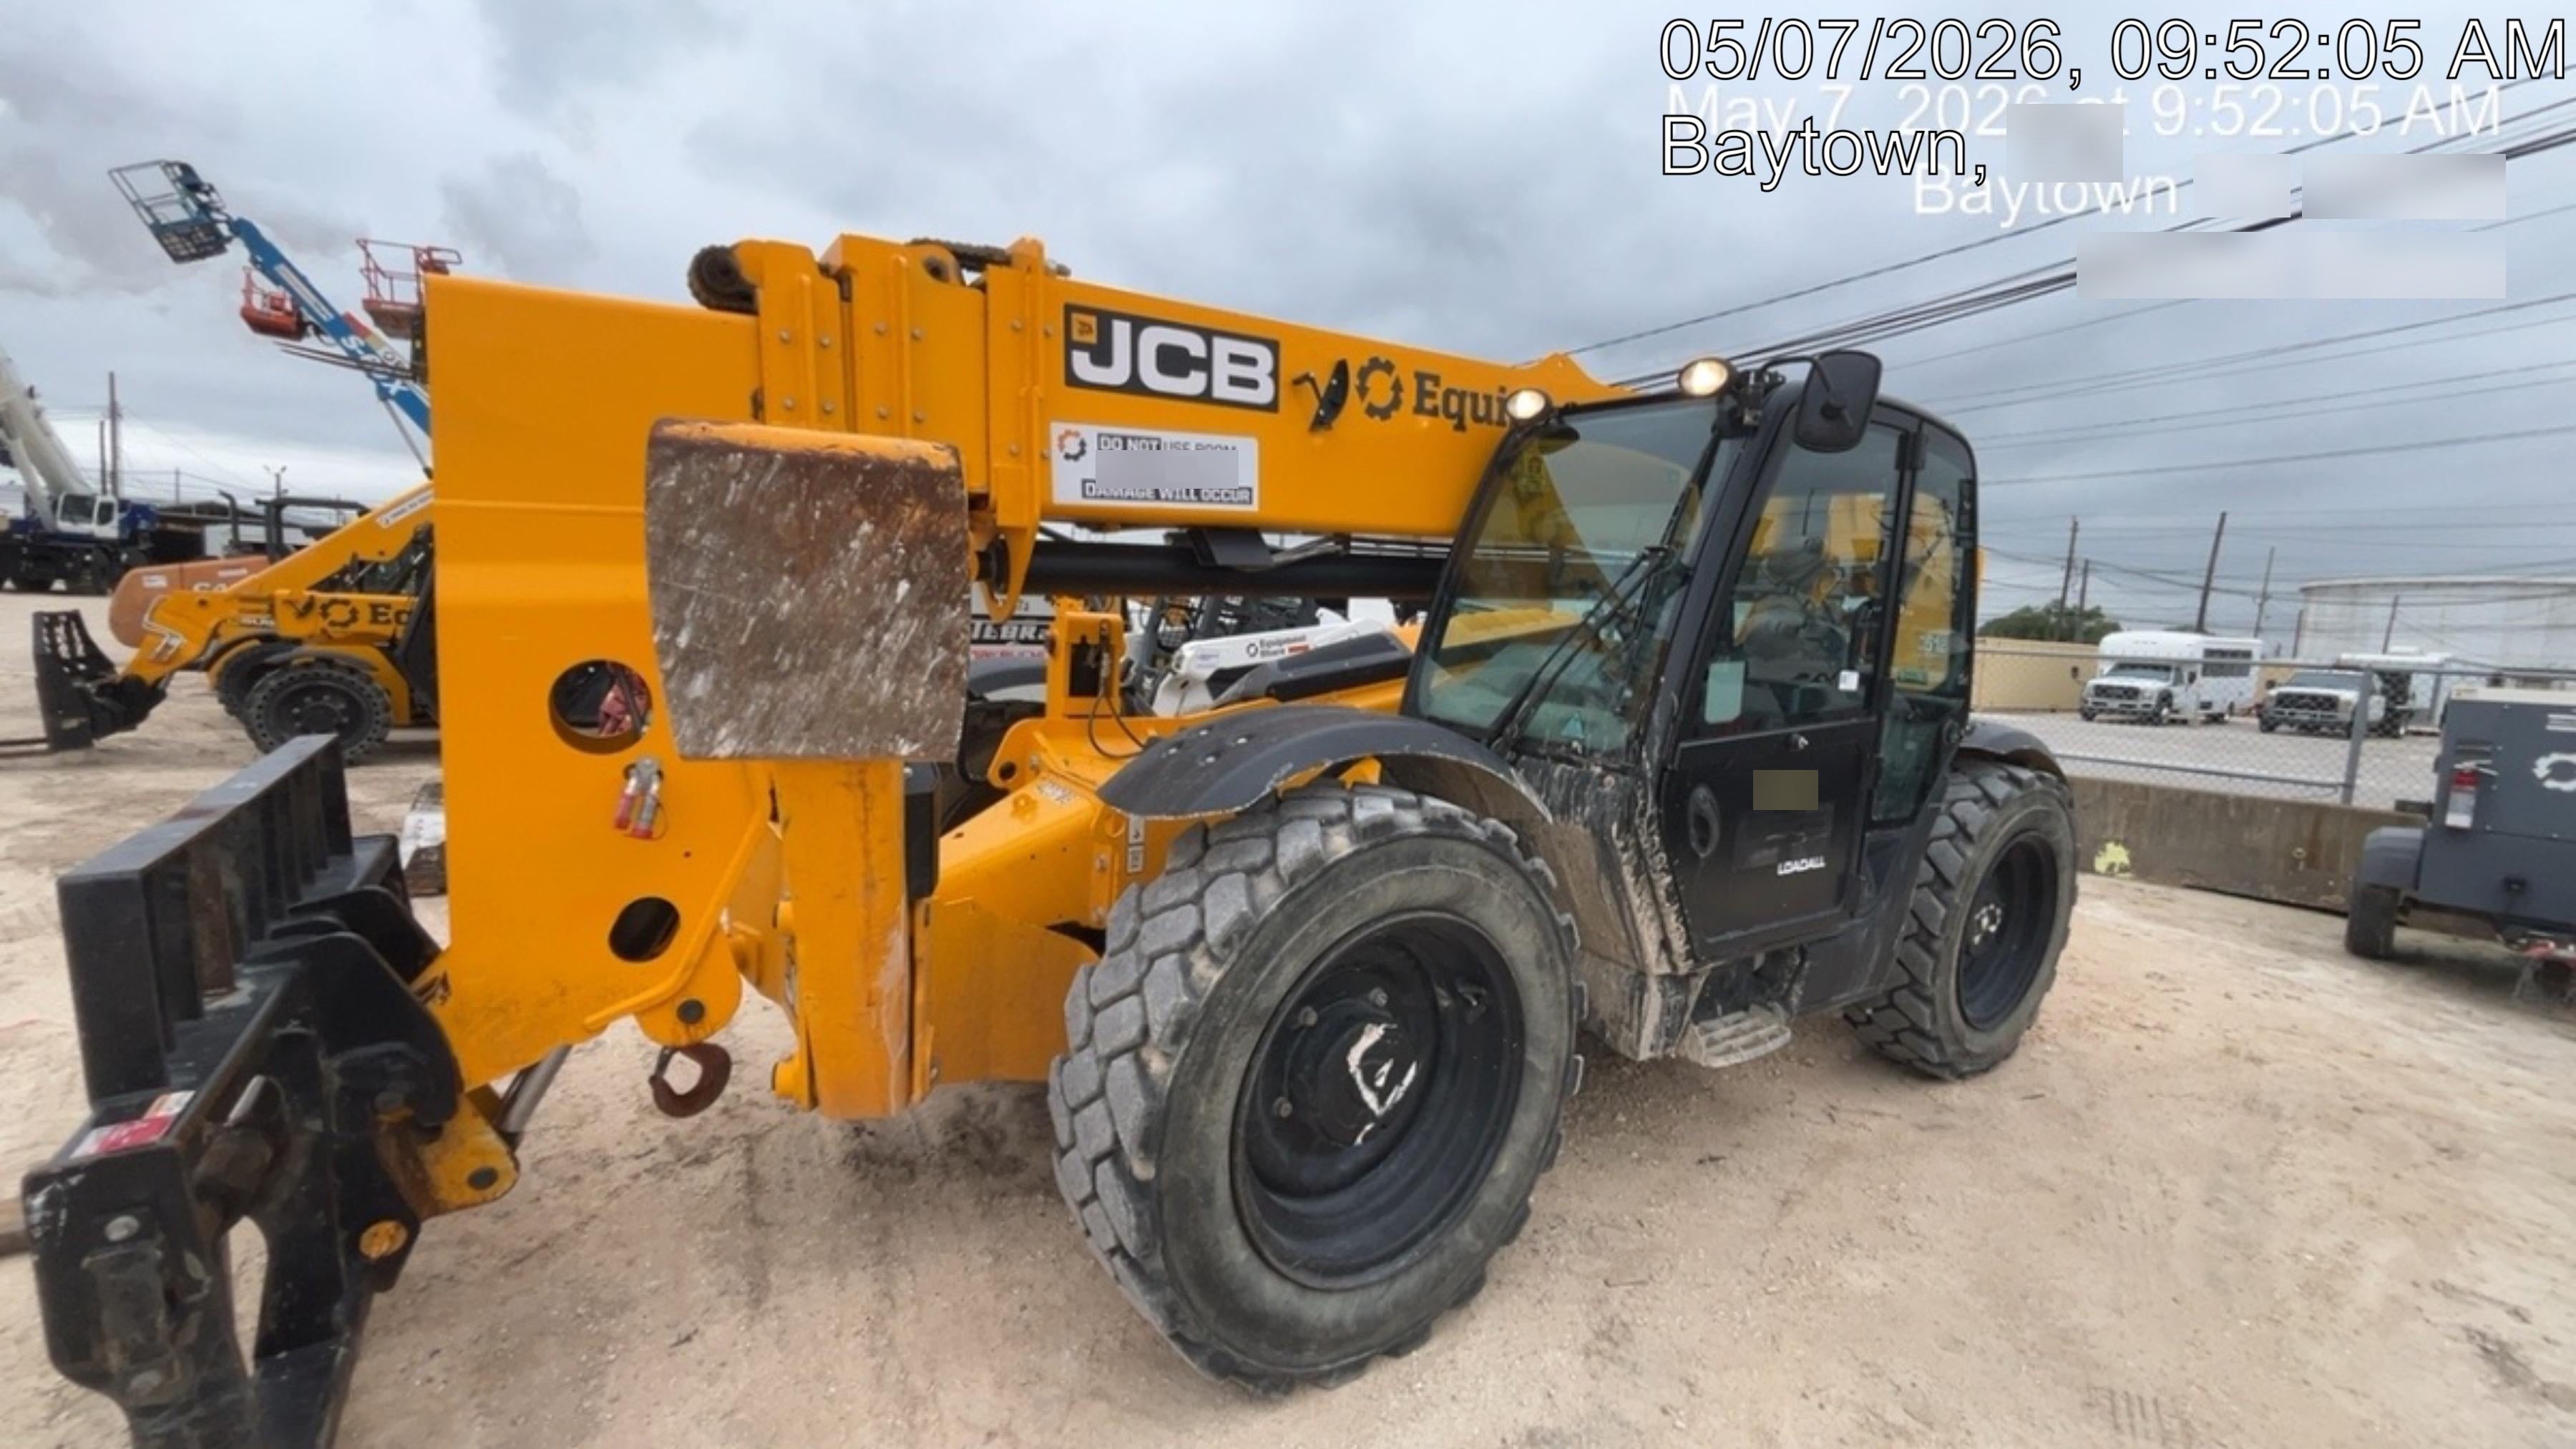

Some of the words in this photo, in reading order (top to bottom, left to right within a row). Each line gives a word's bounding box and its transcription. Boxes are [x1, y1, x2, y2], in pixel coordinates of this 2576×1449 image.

[1070, 318, 1275, 405] JCB
[1101, 436, 1123, 451] DO
[1201, 488, 1250, 503] OCCUR
[1777, 855, 1825, 876] LOADALL
